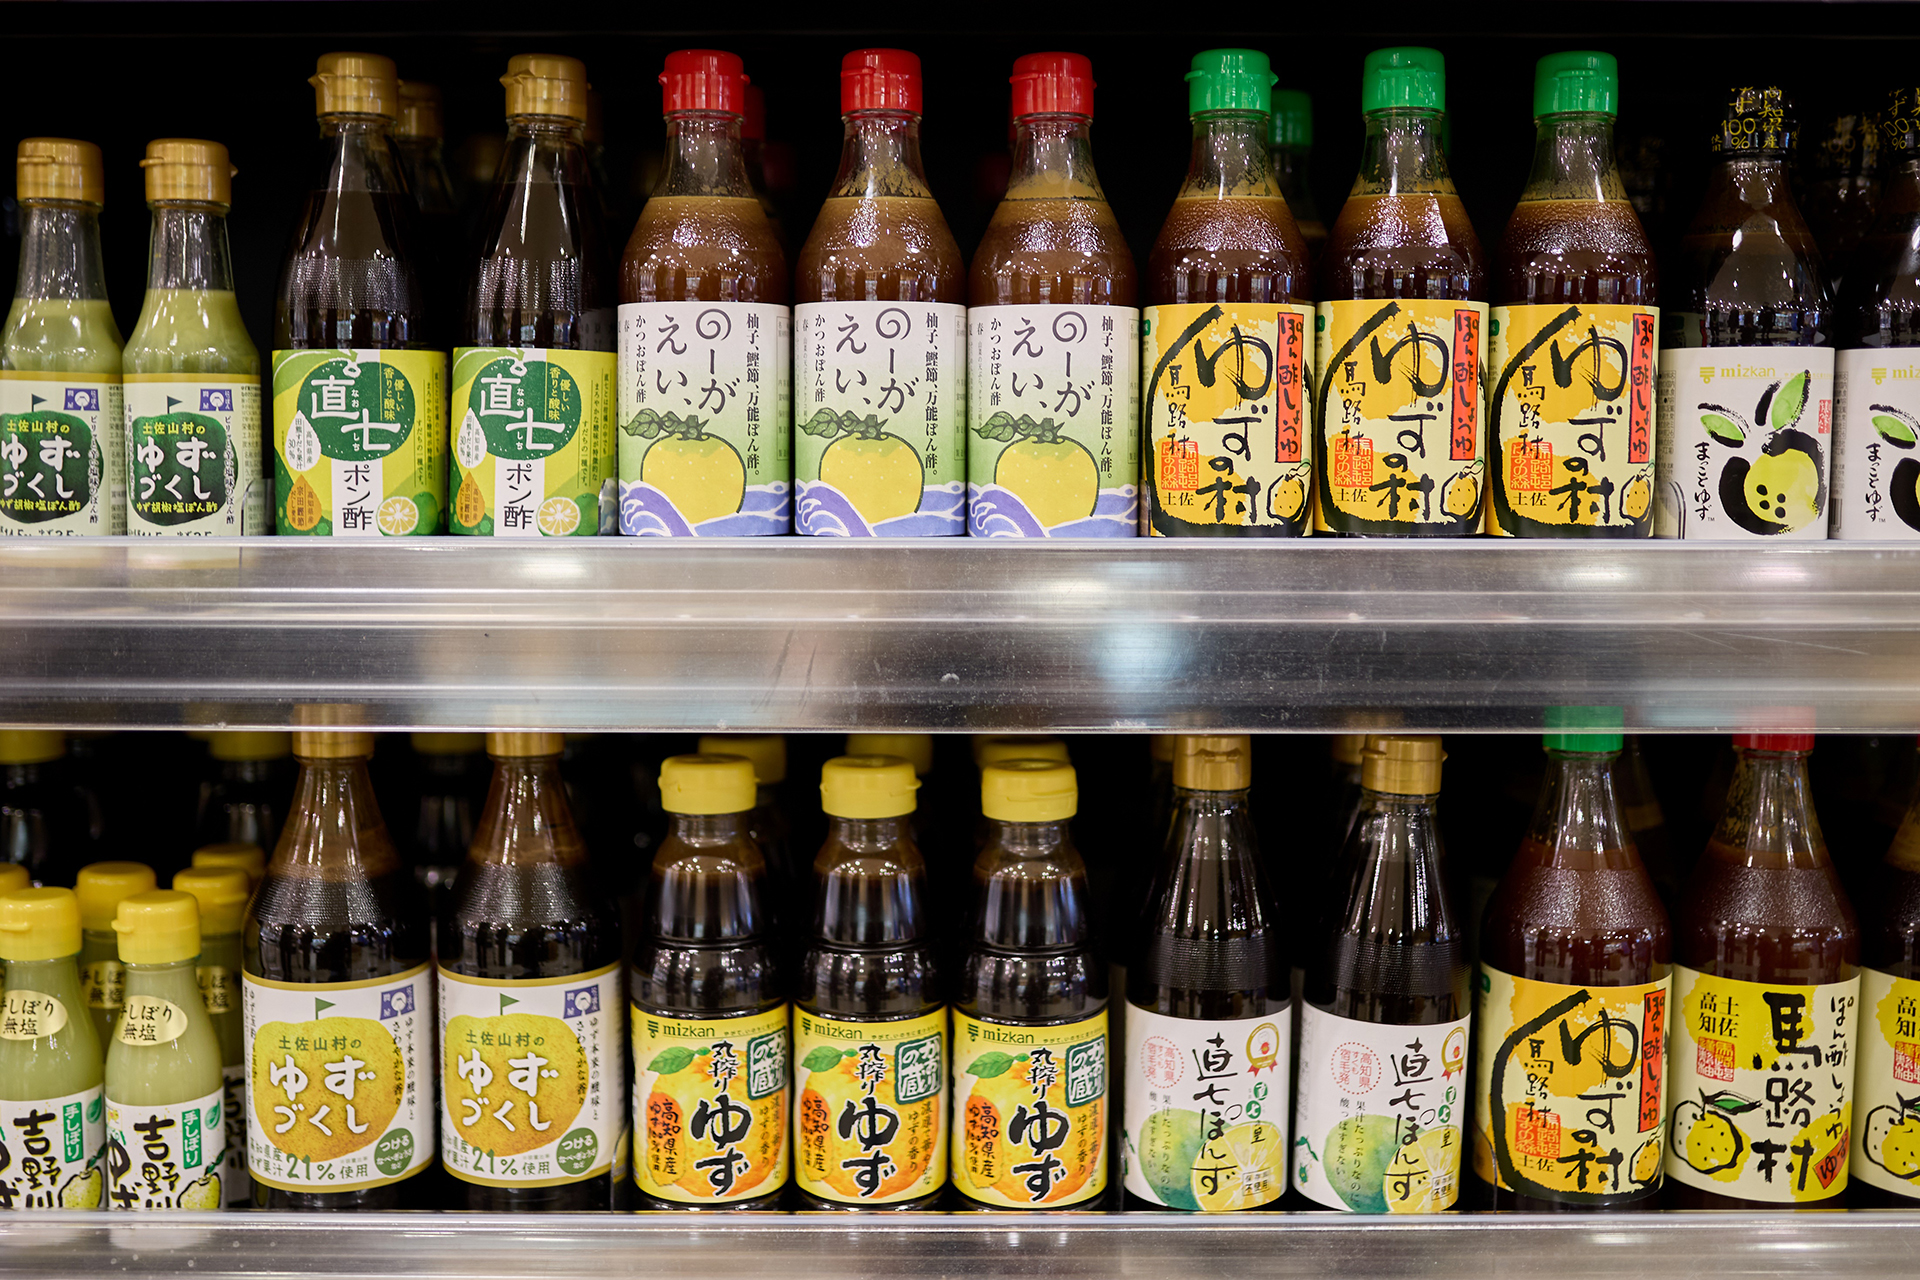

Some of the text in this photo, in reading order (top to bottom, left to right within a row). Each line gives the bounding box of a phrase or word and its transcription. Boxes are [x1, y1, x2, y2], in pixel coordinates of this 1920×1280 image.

[635, 315, 647, 404] かつおぽん酢
[815, 314, 826, 403] かつおぽん酢
[990, 318, 1002, 406] かつおぽん酢
[1720, 365, 1776, 378] mizkan
[351, 389, 359, 408] なお
[383, 367, 395, 421] 香りと酸味
[394, 379, 405, 411] 優しい
[517, 388, 525, 407] なお
[549, 367, 561, 421] 香りと酸味
[560, 379, 571, 411] 優しい
[746, 313, 760, 476] 柚子、鰹節、万能ぽん酢。
[925, 312, 939, 475] 柚子、鰹節、万能ぽん酢。
[1100, 316, 1114, 479] 柚子、鰹節、万能ぽん酢。
[1279, 316, 1303, 458] ぽん酢しょうゆ
[1455, 313, 1479, 457] ぽん酢しょうゆ
[1632, 318, 1654, 460] ぽん酢しょうゆ
[7, 419, 70, 434] 土佐山村の
[143, 421, 205, 434] 土佐山村の
[311, 375, 401, 451] 直七
[479, 373, 565, 450] 直七
[1166, 364, 1191, 458] 馬路村
[1341, 361, 1366, 455] 馬路村
[1517, 365, 1545, 460] 馬路村
[1, 433, 81, 472] ゆず
[137, 436, 217, 473] ゆず
[352, 432, 360, 451] しち
[516, 431, 523, 450] しち
[3, 471, 75, 499] づくし
[139, 473, 211, 500] づくし
[342, 463, 374, 530] ポン酢
[504, 462, 535, 530] ポン酢
[1162, 492, 1194, 507] 土佐
[1336, 488, 1368, 503] 土佐
[1512, 492, 1548, 507] 土佐
[1694, 441, 1712, 521] まっことゆず
[1865, 443, 1883, 522] まっことゆず
[3, 1016, 38, 1036] 無塩
[123, 1022, 156, 1041] 無塩
[663, 1022, 715, 1038] mizkan
[814, 1022, 863, 1040] mizkan
[1698, 992, 1718, 1034] 高知
[1718, 996, 1740, 1038] 土佐
[1895, 996, 1916, 1038] 高知
[278, 1035, 361, 1051] 土佐山村の
[465, 1030, 544, 1047] 土佐山村の
[983, 1028, 1034, 1044] mizkan
[270, 1054, 376, 1101] ゆず
[458, 1048, 559, 1098] ゆず
[708, 1040, 739, 1093] 丸搾り
[855, 1043, 888, 1096] 丸搾り
[1027, 1047, 1058, 1099] 丸搾り
[1164, 1046, 1176, 1083] 高知県
[1339, 1048, 1351, 1085] 宿毛発
[1359, 1052, 1372, 1088] 高知県
[1643, 996, 1665, 1125] ぽん酢しょうゆ
[1825, 995, 1855, 1140] ぽん酢しょうゆ
[1524, 1038, 1553, 1128] 馬路村
[1750, 991, 1822, 1191] 馬路村
[65, 1104, 80, 1160] 手しぼり
[273, 1103, 369, 1137] づくし
[461, 1097, 552, 1132] づくし
[812, 1096, 829, 1172] 高知県産
[183, 1111, 200, 1166] 手しぼり
[379, 1134, 410, 1152] つける
[561, 1134, 594, 1151] つける
[661, 1098, 681, 1175] 高知県産
[691, 1094, 751, 1196] ゆず
[838, 1096, 899, 1197] ゆず
[980, 1103, 999, 1178] 高知県産
[1009, 1100, 1069, 1202] ゆず
[286, 1152, 336, 1181] 21%
[340, 1163, 368, 1179] 使用
[472, 1146, 518, 1176] 21%
[522, 1161, 550, 1175] 使用
[1517, 1155, 1554, 1173] 土佐
